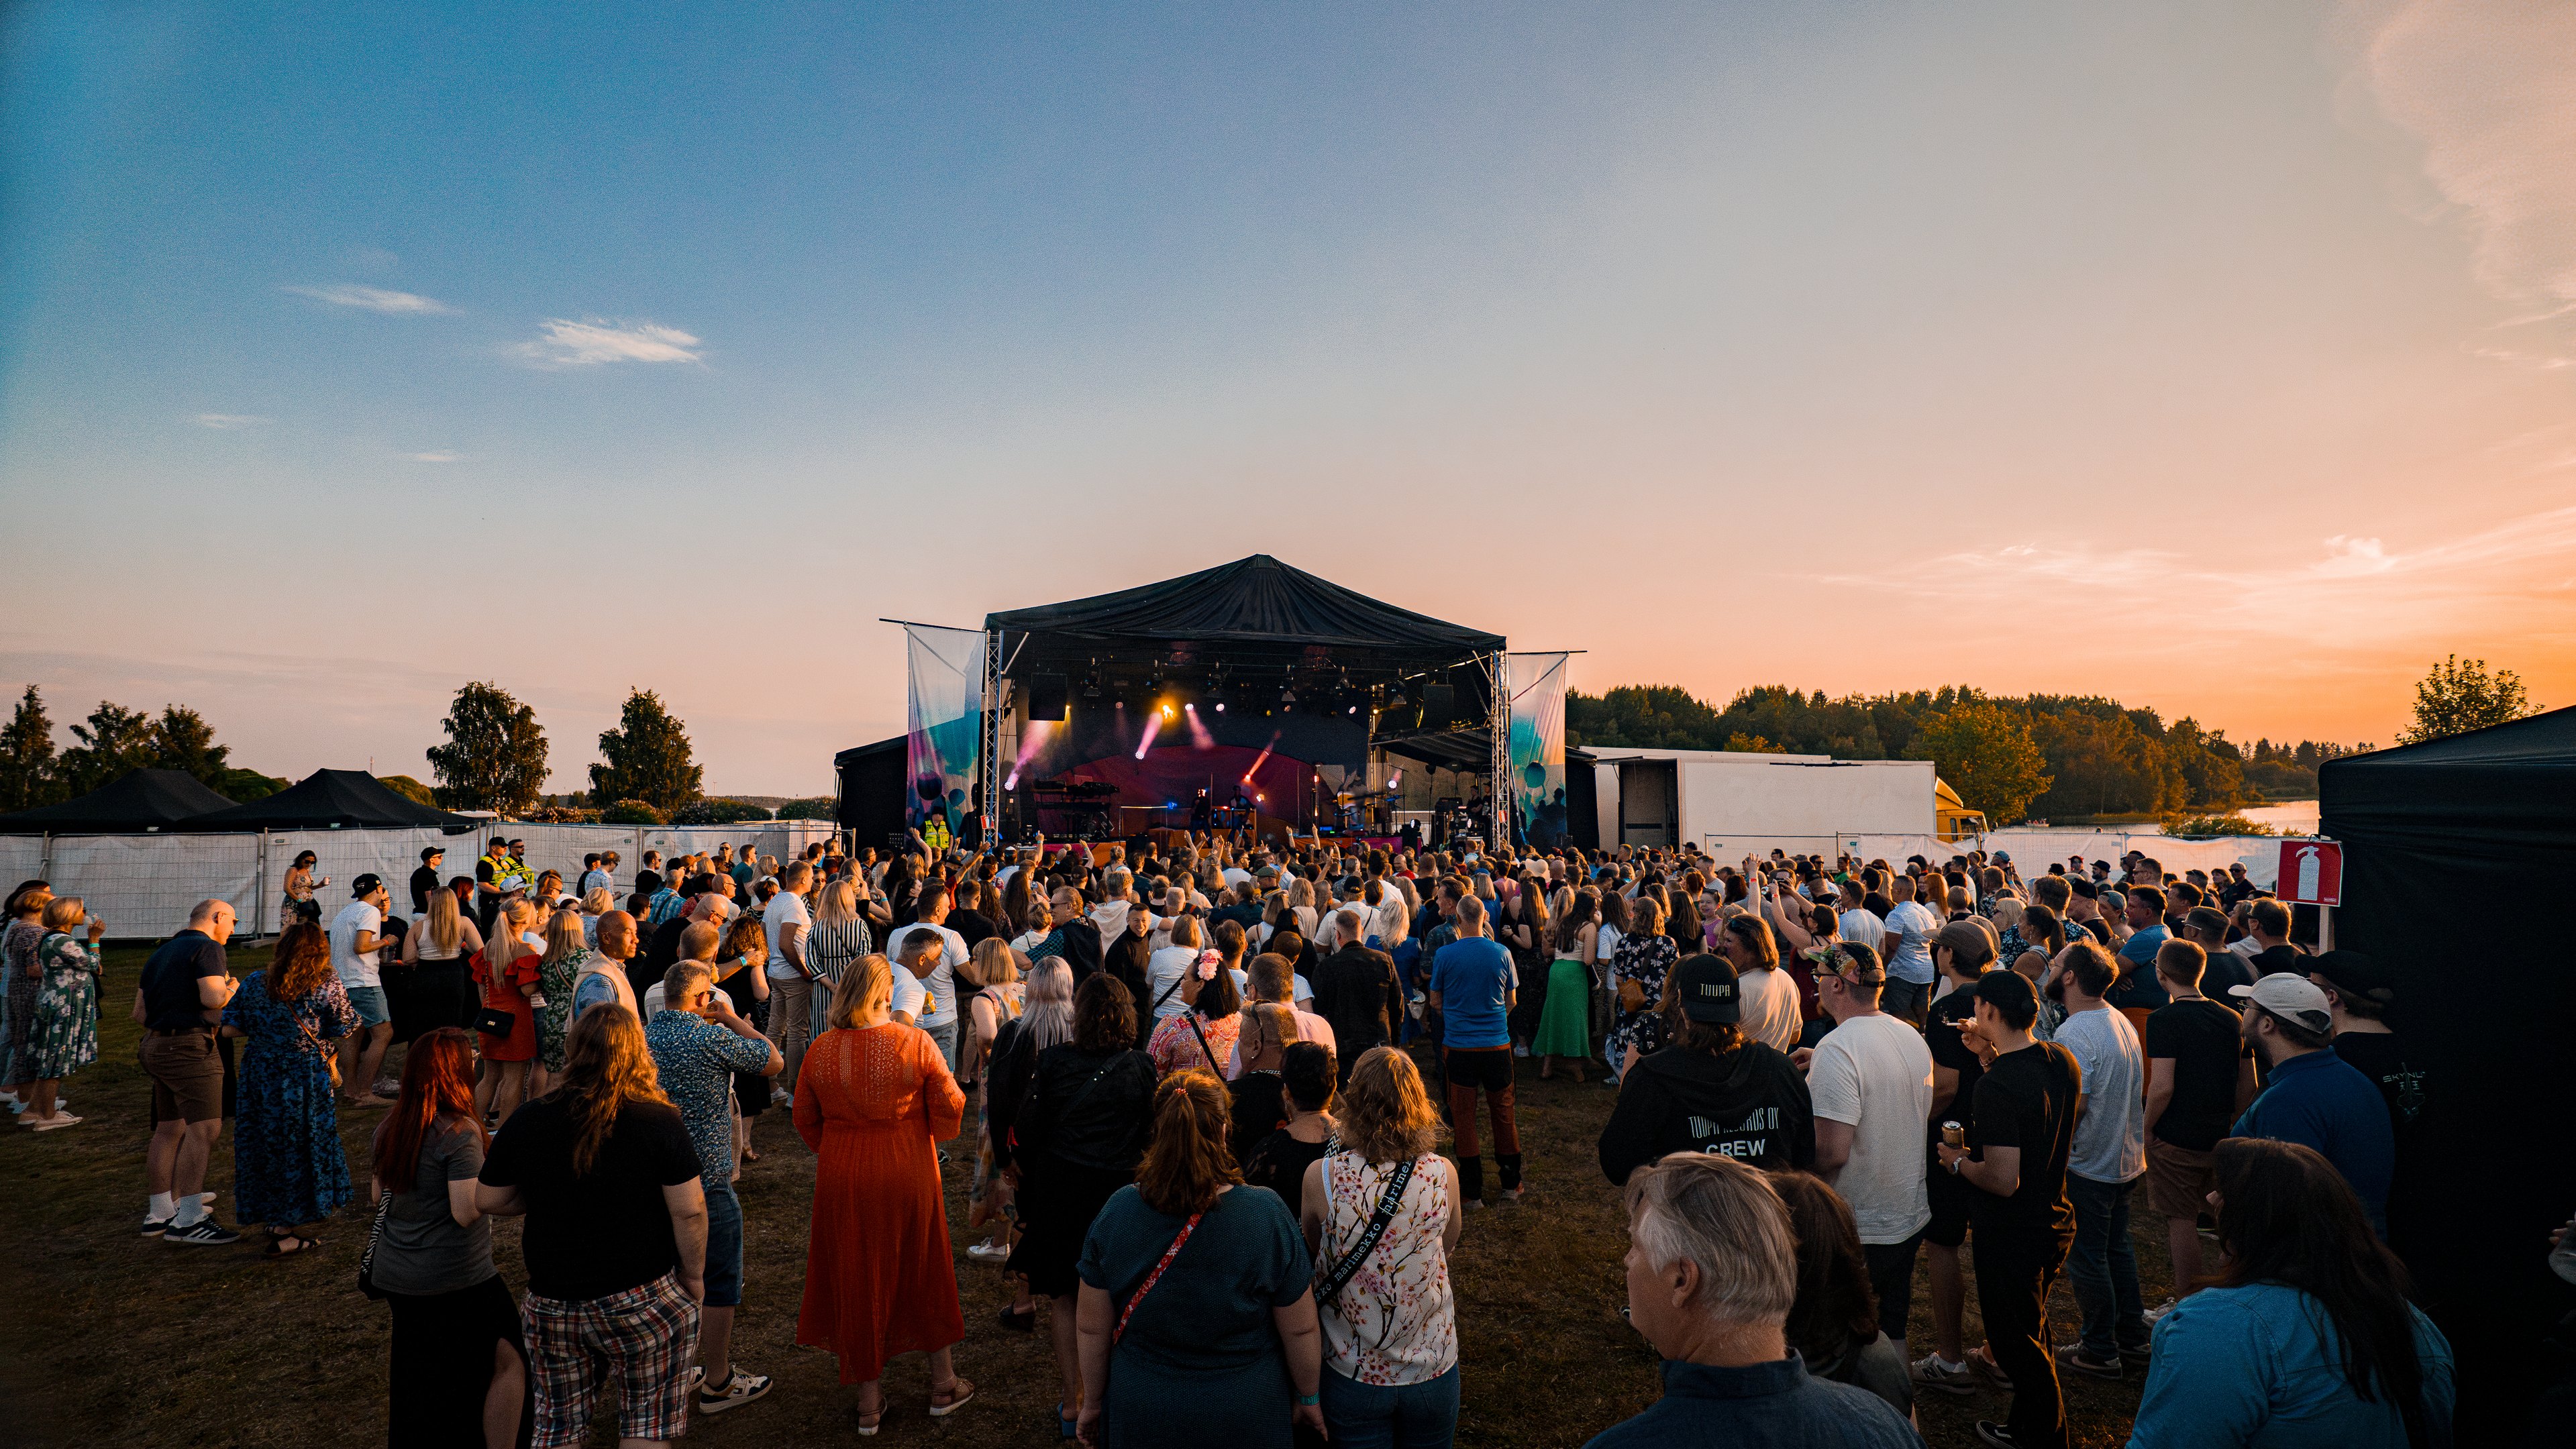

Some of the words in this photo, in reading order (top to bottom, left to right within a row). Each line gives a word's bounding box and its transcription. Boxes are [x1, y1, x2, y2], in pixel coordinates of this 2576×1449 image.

[1700, 983, 1731, 997] TUUPA
[1768, 1107, 1779, 1130] OY
[1706, 1139, 1766, 1157] CREW
[1334, 1223, 1381, 1281] marimekko
